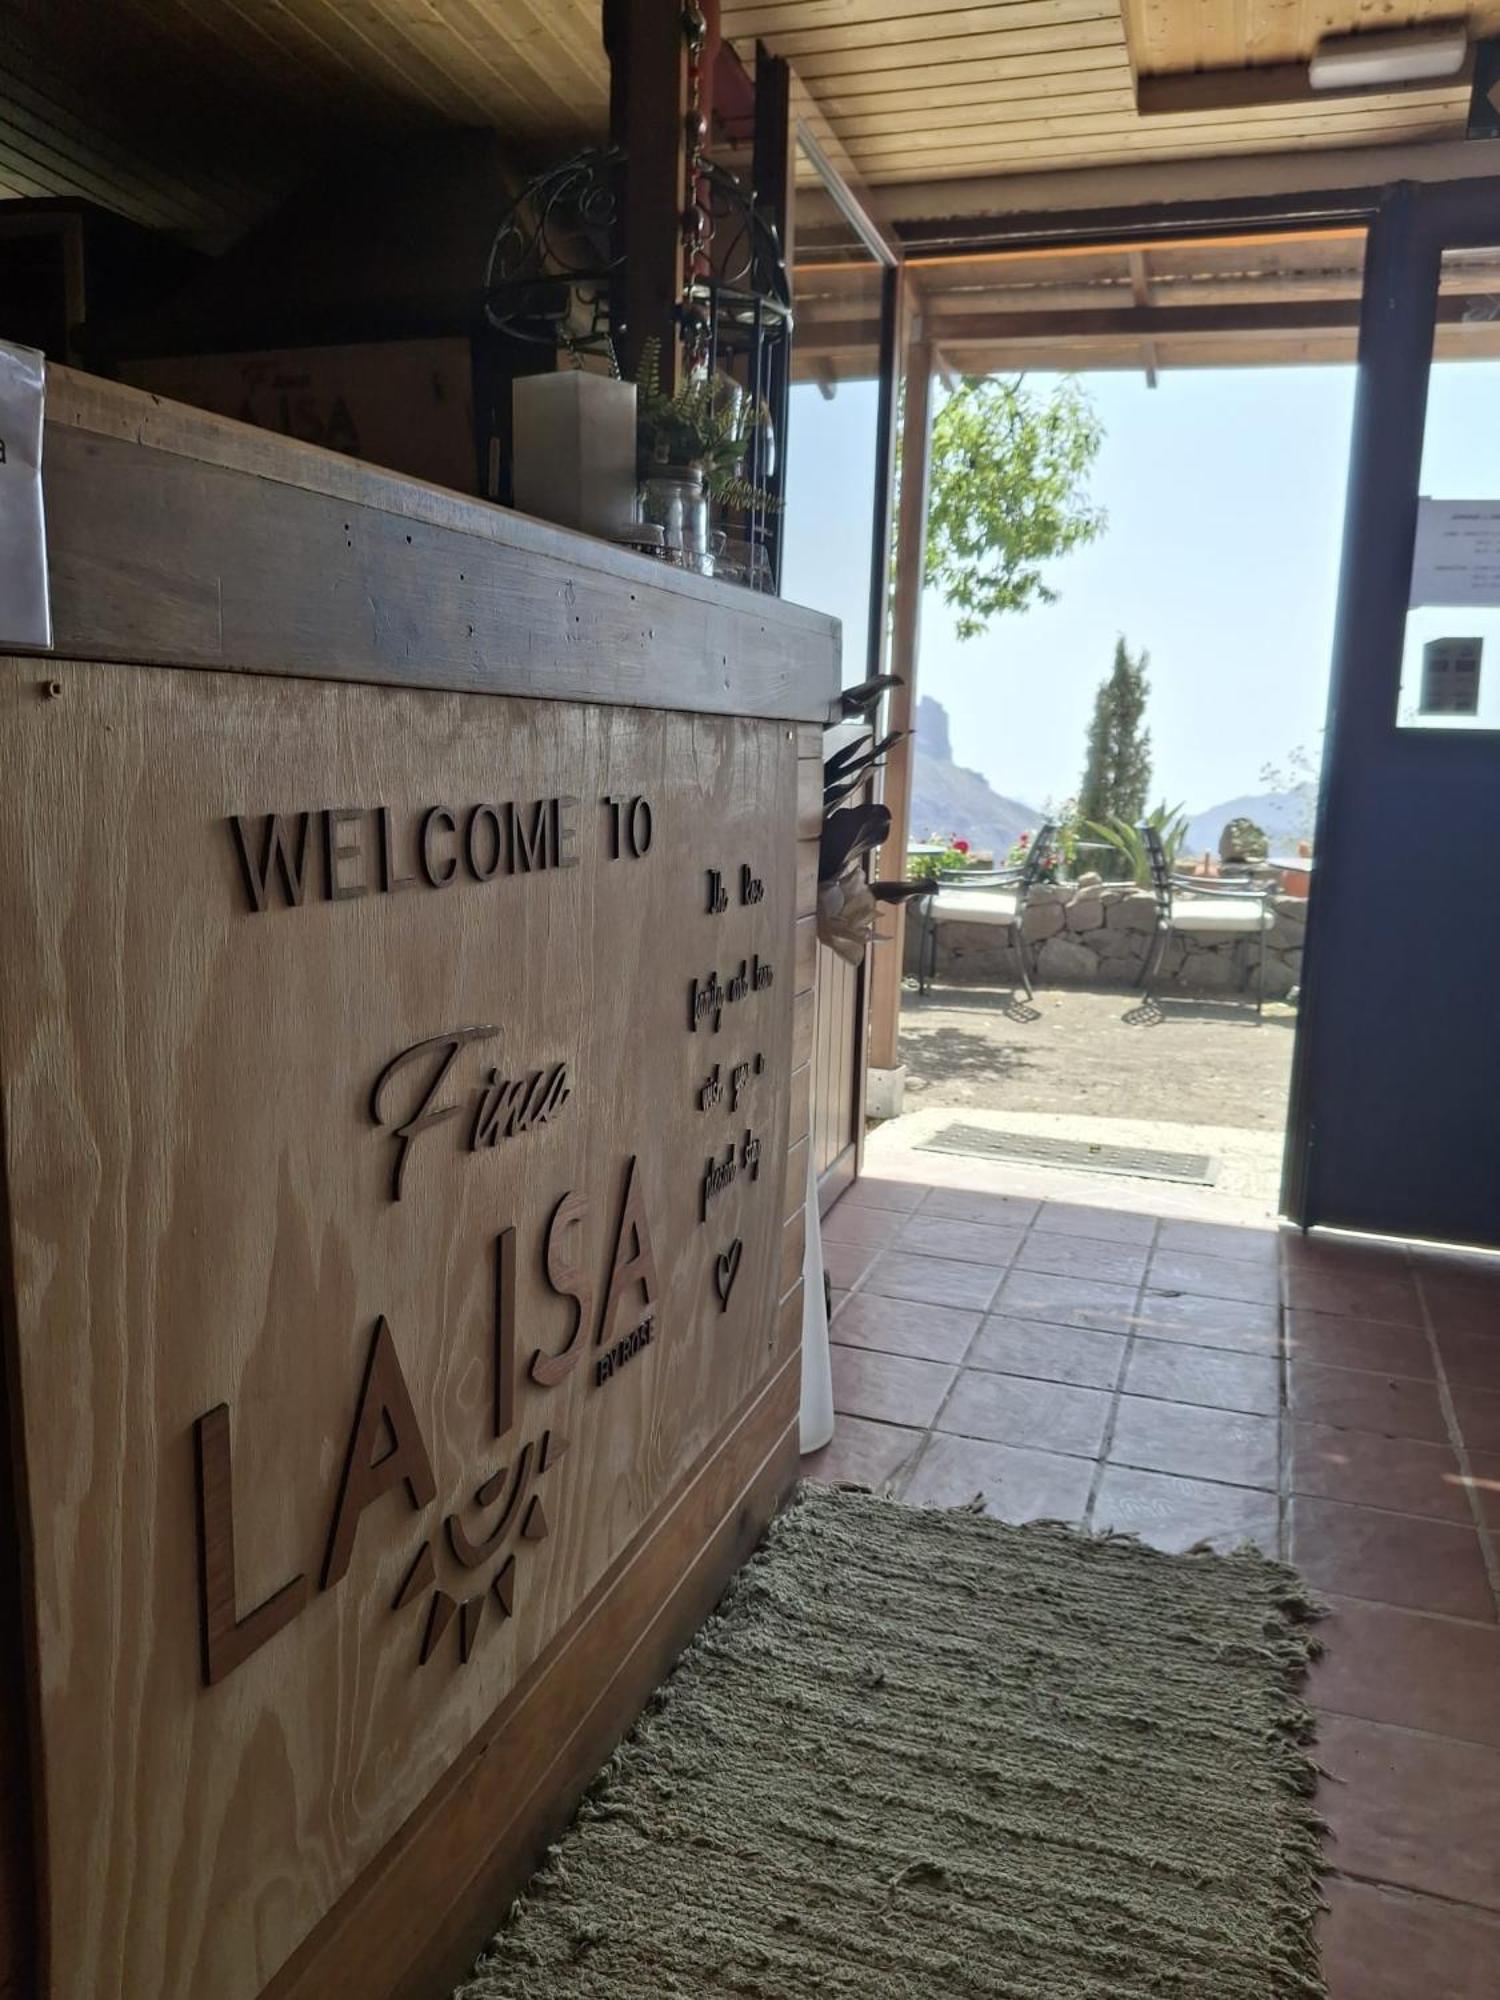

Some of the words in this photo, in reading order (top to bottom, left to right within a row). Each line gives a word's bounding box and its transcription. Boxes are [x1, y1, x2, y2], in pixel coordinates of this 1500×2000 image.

[229, 798, 580, 912] WELCOME
[604, 795, 653, 860] TO
[596, 1348, 617, 1387] BY
[618, 1314, 655, 1368] ROSE
